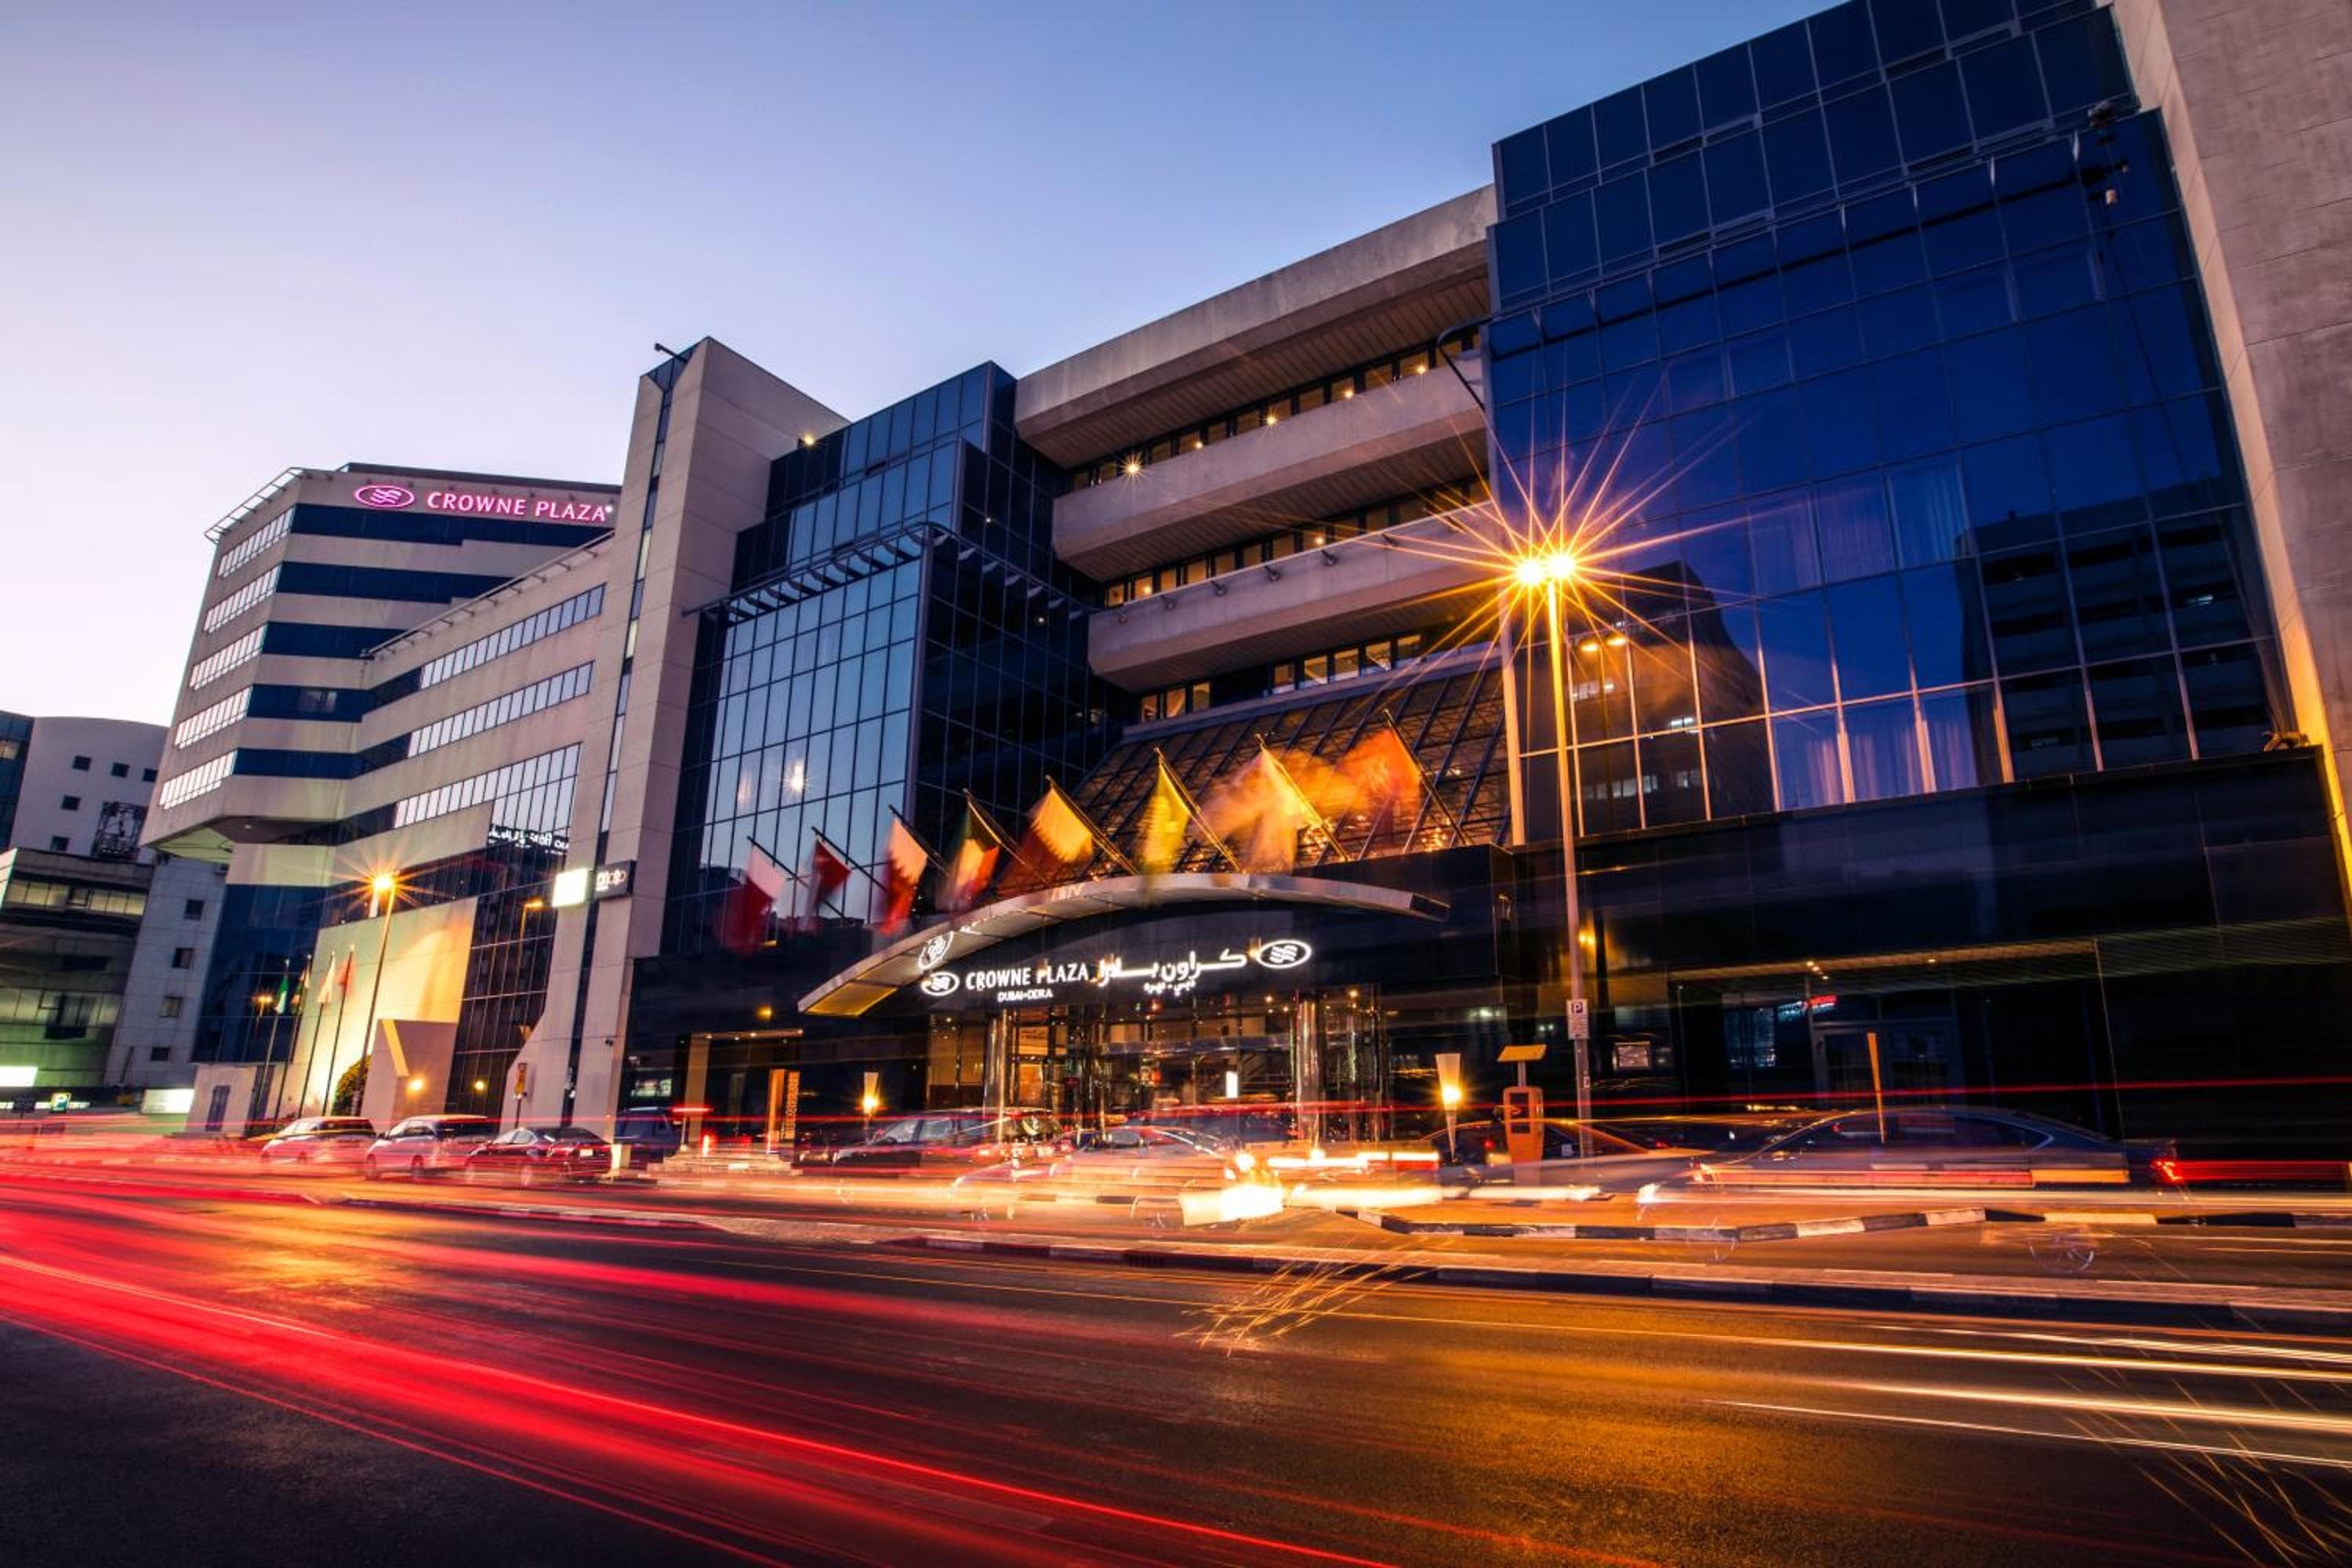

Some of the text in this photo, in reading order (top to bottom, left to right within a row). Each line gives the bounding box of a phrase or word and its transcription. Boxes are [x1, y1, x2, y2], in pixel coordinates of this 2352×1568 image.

[426, 492, 606, 521] CROWNE PLAZA
[965, 963, 1089, 990] CROWNE PLAZA
[1160, 948, 1247, 982] كراون
